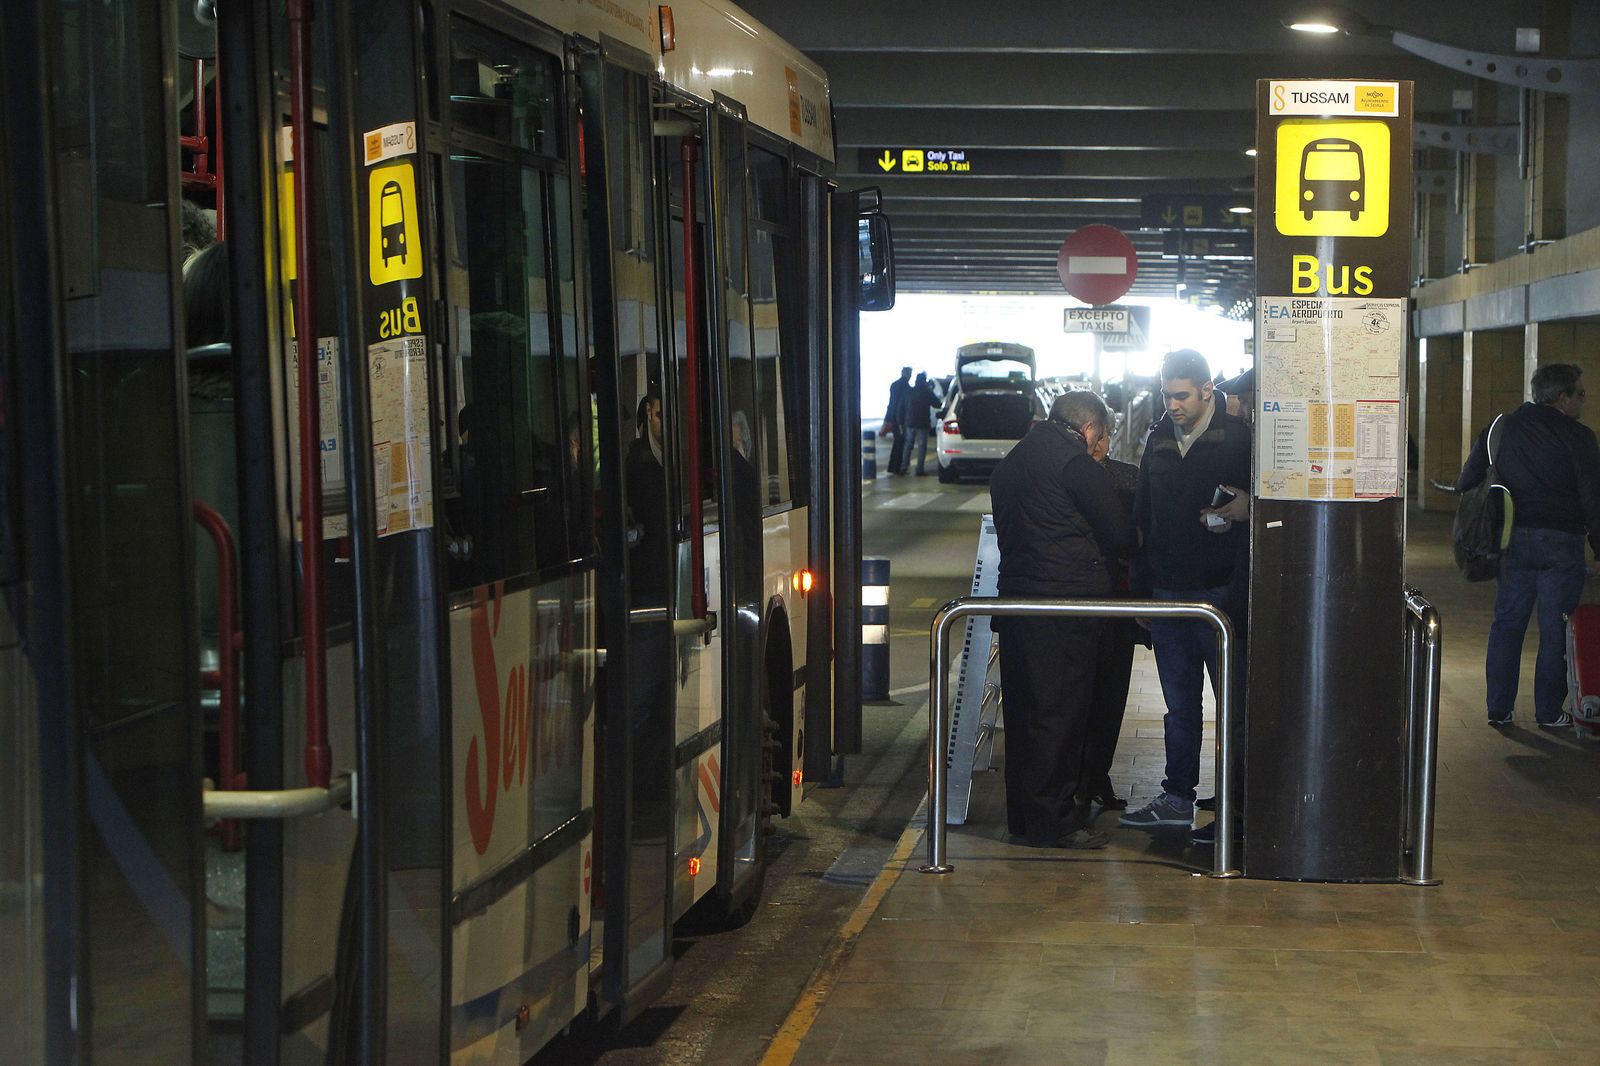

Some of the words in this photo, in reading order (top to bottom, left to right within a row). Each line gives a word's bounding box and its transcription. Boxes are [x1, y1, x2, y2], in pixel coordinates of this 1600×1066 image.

[1291, 92, 1349, 104] TUSSAM
[927, 151, 946, 161] Only
[948, 151, 965, 160] Taxi
[928, 161, 948, 171] Solo
[951, 161, 970, 171] Taxi
[1291, 254, 1374, 296] Bus
[1291, 300, 1327, 309] ESPECIA
[1069, 311, 1125, 320] EXCEPTO
[1269, 306, 1290, 318] EA
[1080, 321, 1114, 331] TAXIS
[1263, 401, 1281, 412] EA
